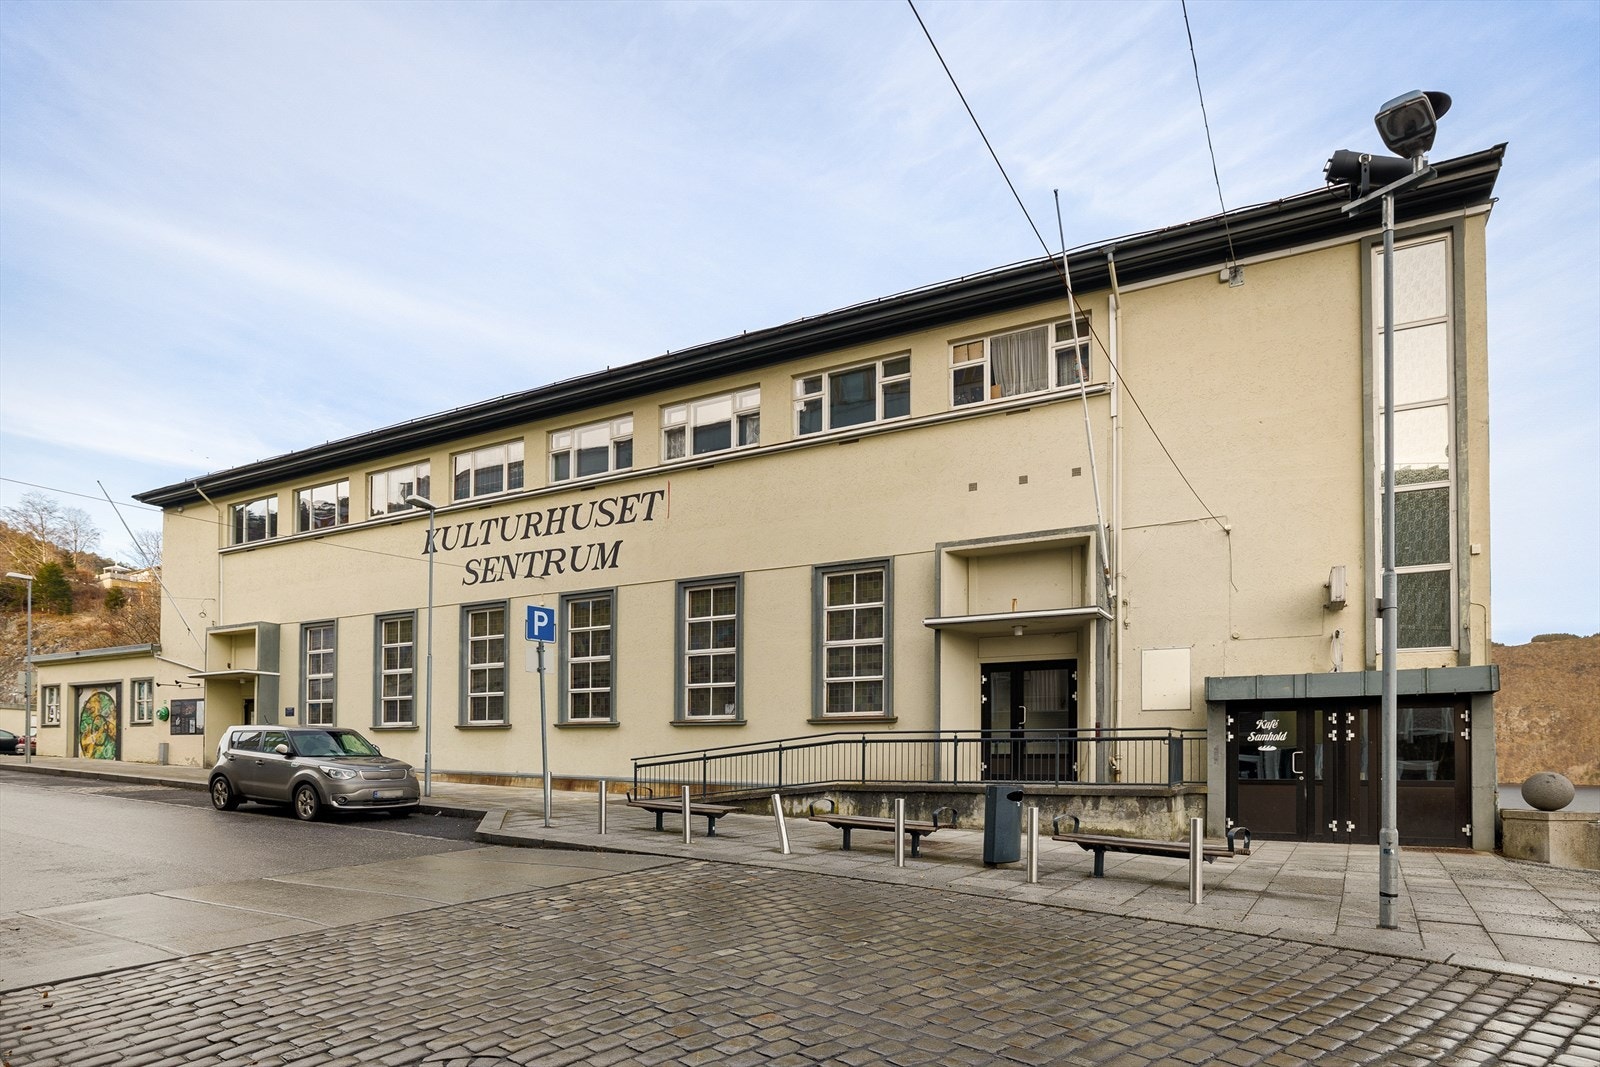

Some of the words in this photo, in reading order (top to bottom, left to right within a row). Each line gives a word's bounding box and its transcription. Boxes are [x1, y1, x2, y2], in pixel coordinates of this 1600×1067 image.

[421, 490, 665, 555] KULTURHUSET
[462, 540, 623, 586] SENTRUM
[533, 610, 549, 636] P
[1247, 731, 1288, 742] Samhold
[1256, 719, 1279, 731] Kafé
